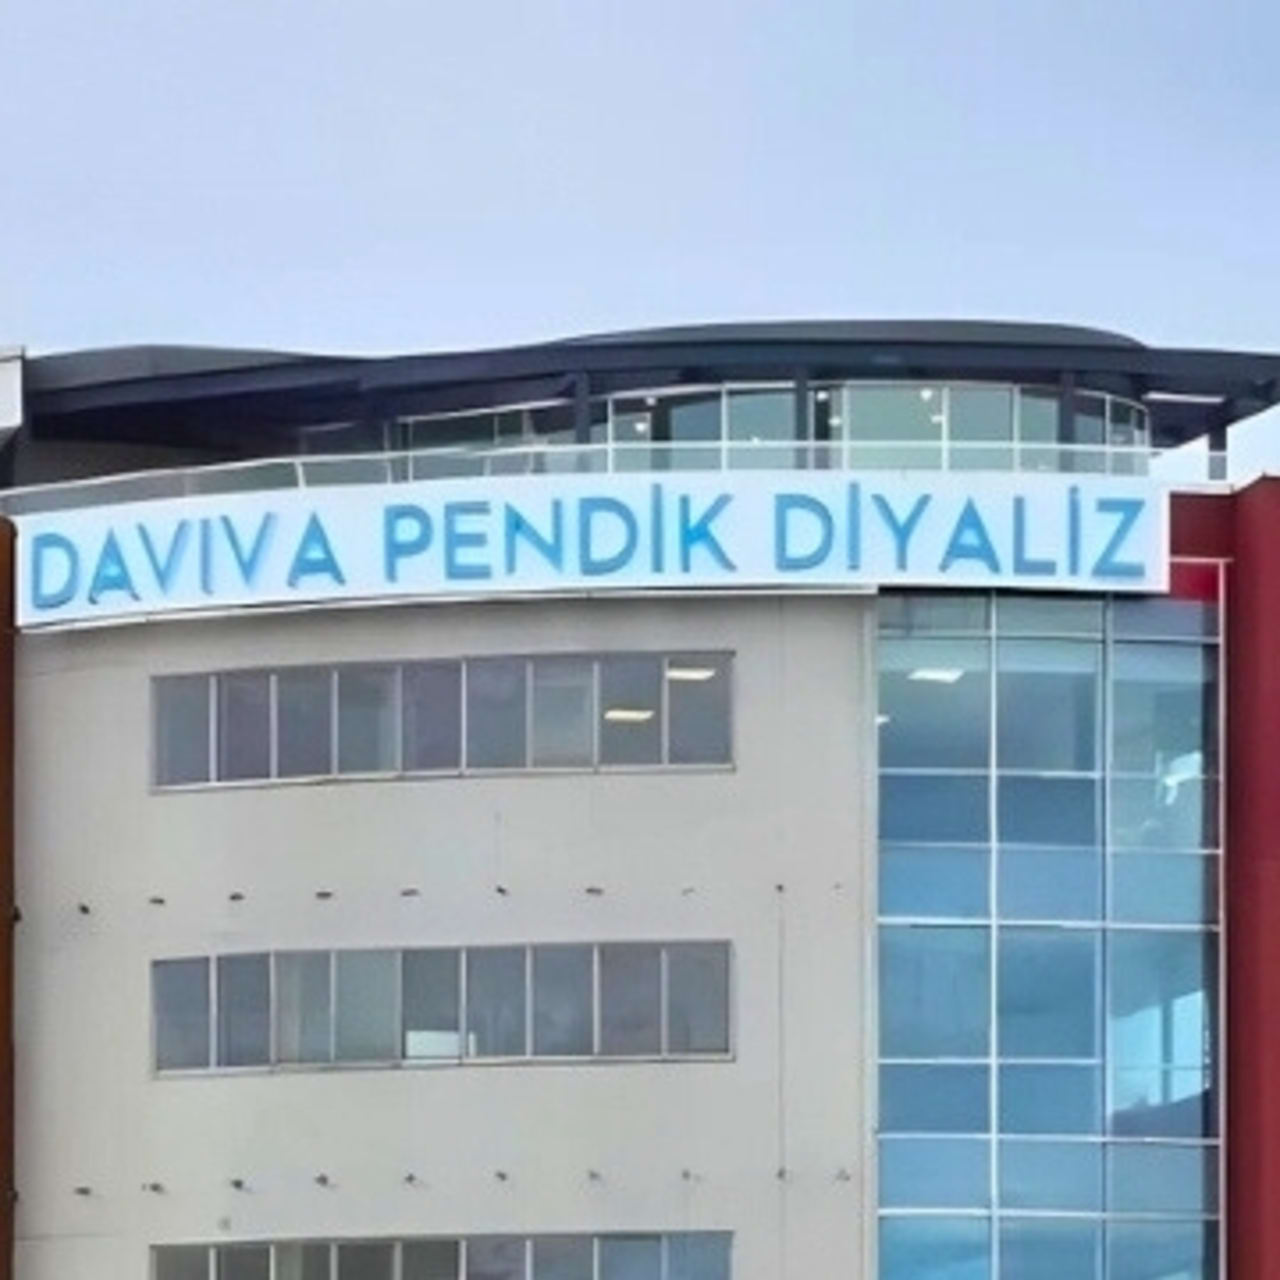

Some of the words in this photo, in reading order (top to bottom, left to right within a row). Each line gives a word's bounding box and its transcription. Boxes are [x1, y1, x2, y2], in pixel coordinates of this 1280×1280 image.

[29, 512, 347, 612] DAVIVA
[382, 483, 736, 582] PENDİK
[772, 481, 1150, 578] DİYALİZ
